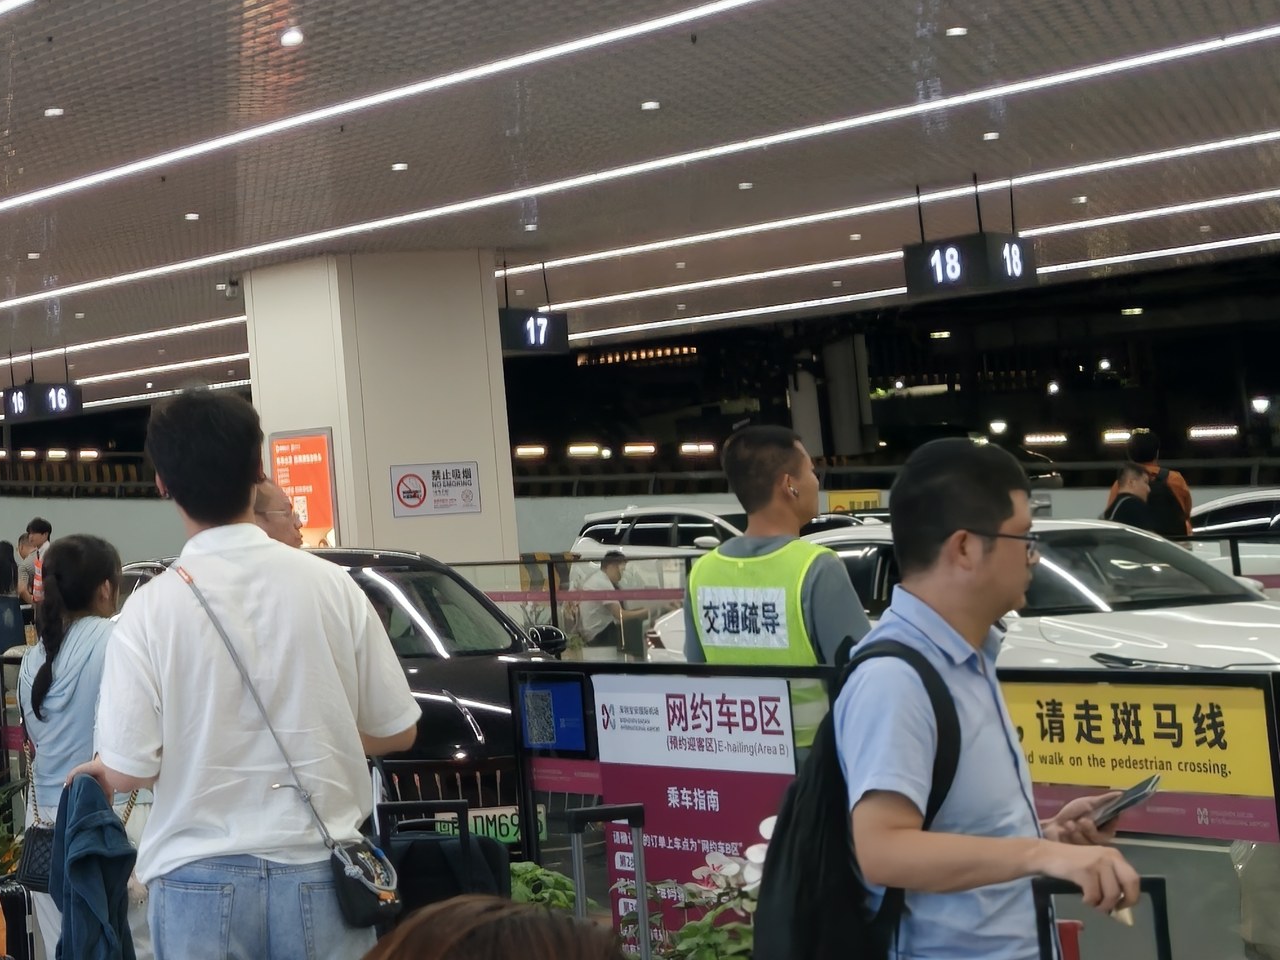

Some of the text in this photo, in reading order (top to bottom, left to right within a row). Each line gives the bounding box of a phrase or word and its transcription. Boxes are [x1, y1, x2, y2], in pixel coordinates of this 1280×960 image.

[931, 247, 961, 283] 18
[1003, 243, 1022, 277] 18
[526, 316, 548, 345] 17
[12, 391, 24, 414] 16
[48, 388, 68, 410] 16
[432, 468, 472, 481] 禁止吸烟
[703, 601, 780, 634] 交通疏导
[665, 692, 785, 736] 网约车B区
[1039, 752, 1064, 765] walk
[1069, 756, 1083, 767] on
[1087, 754, 1106, 768] the
[1111, 756, 1172, 772] pedestrian
[667, 787, 720, 812] 乘车指南
